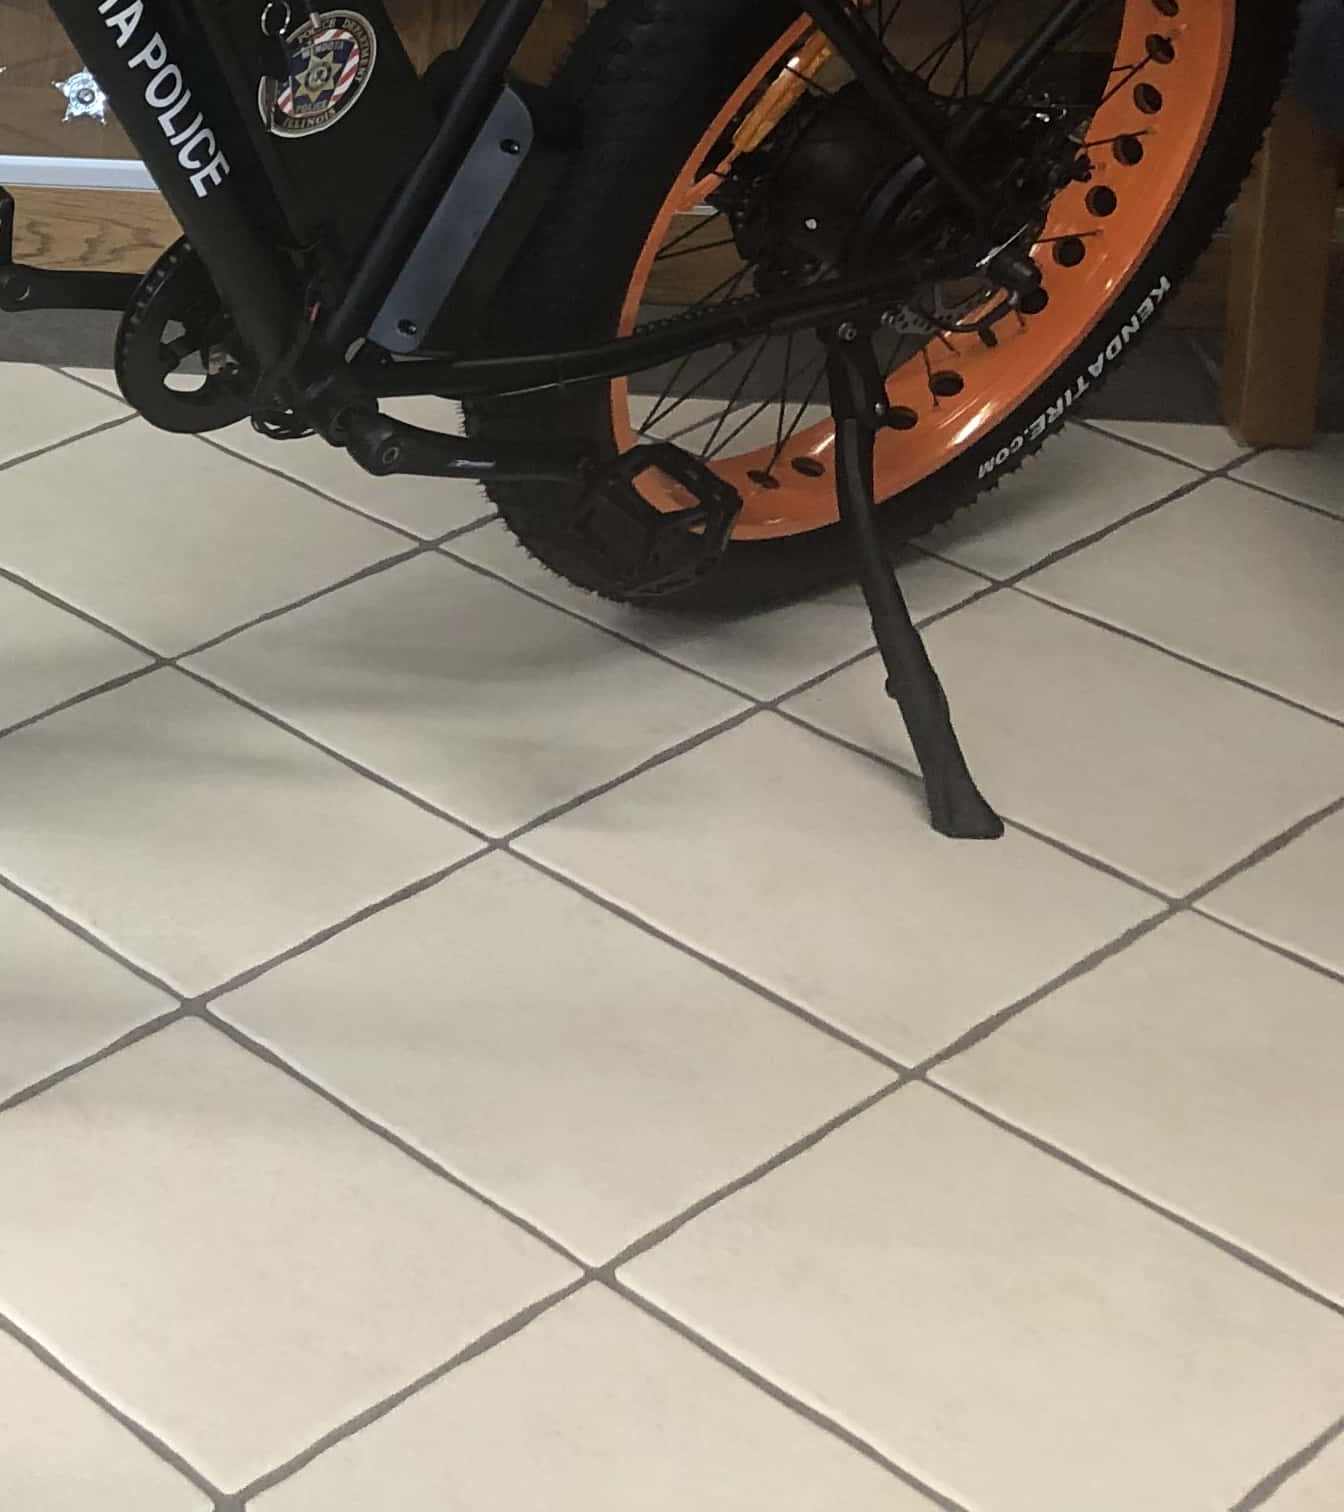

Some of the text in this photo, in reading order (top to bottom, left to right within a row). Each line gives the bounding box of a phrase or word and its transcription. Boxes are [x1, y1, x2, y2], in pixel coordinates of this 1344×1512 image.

[126, 31, 233, 199] POLICE
[283, 106, 337, 129] ILLINOIS
[977, 274, 1172, 479] KENDATIRE.COM
